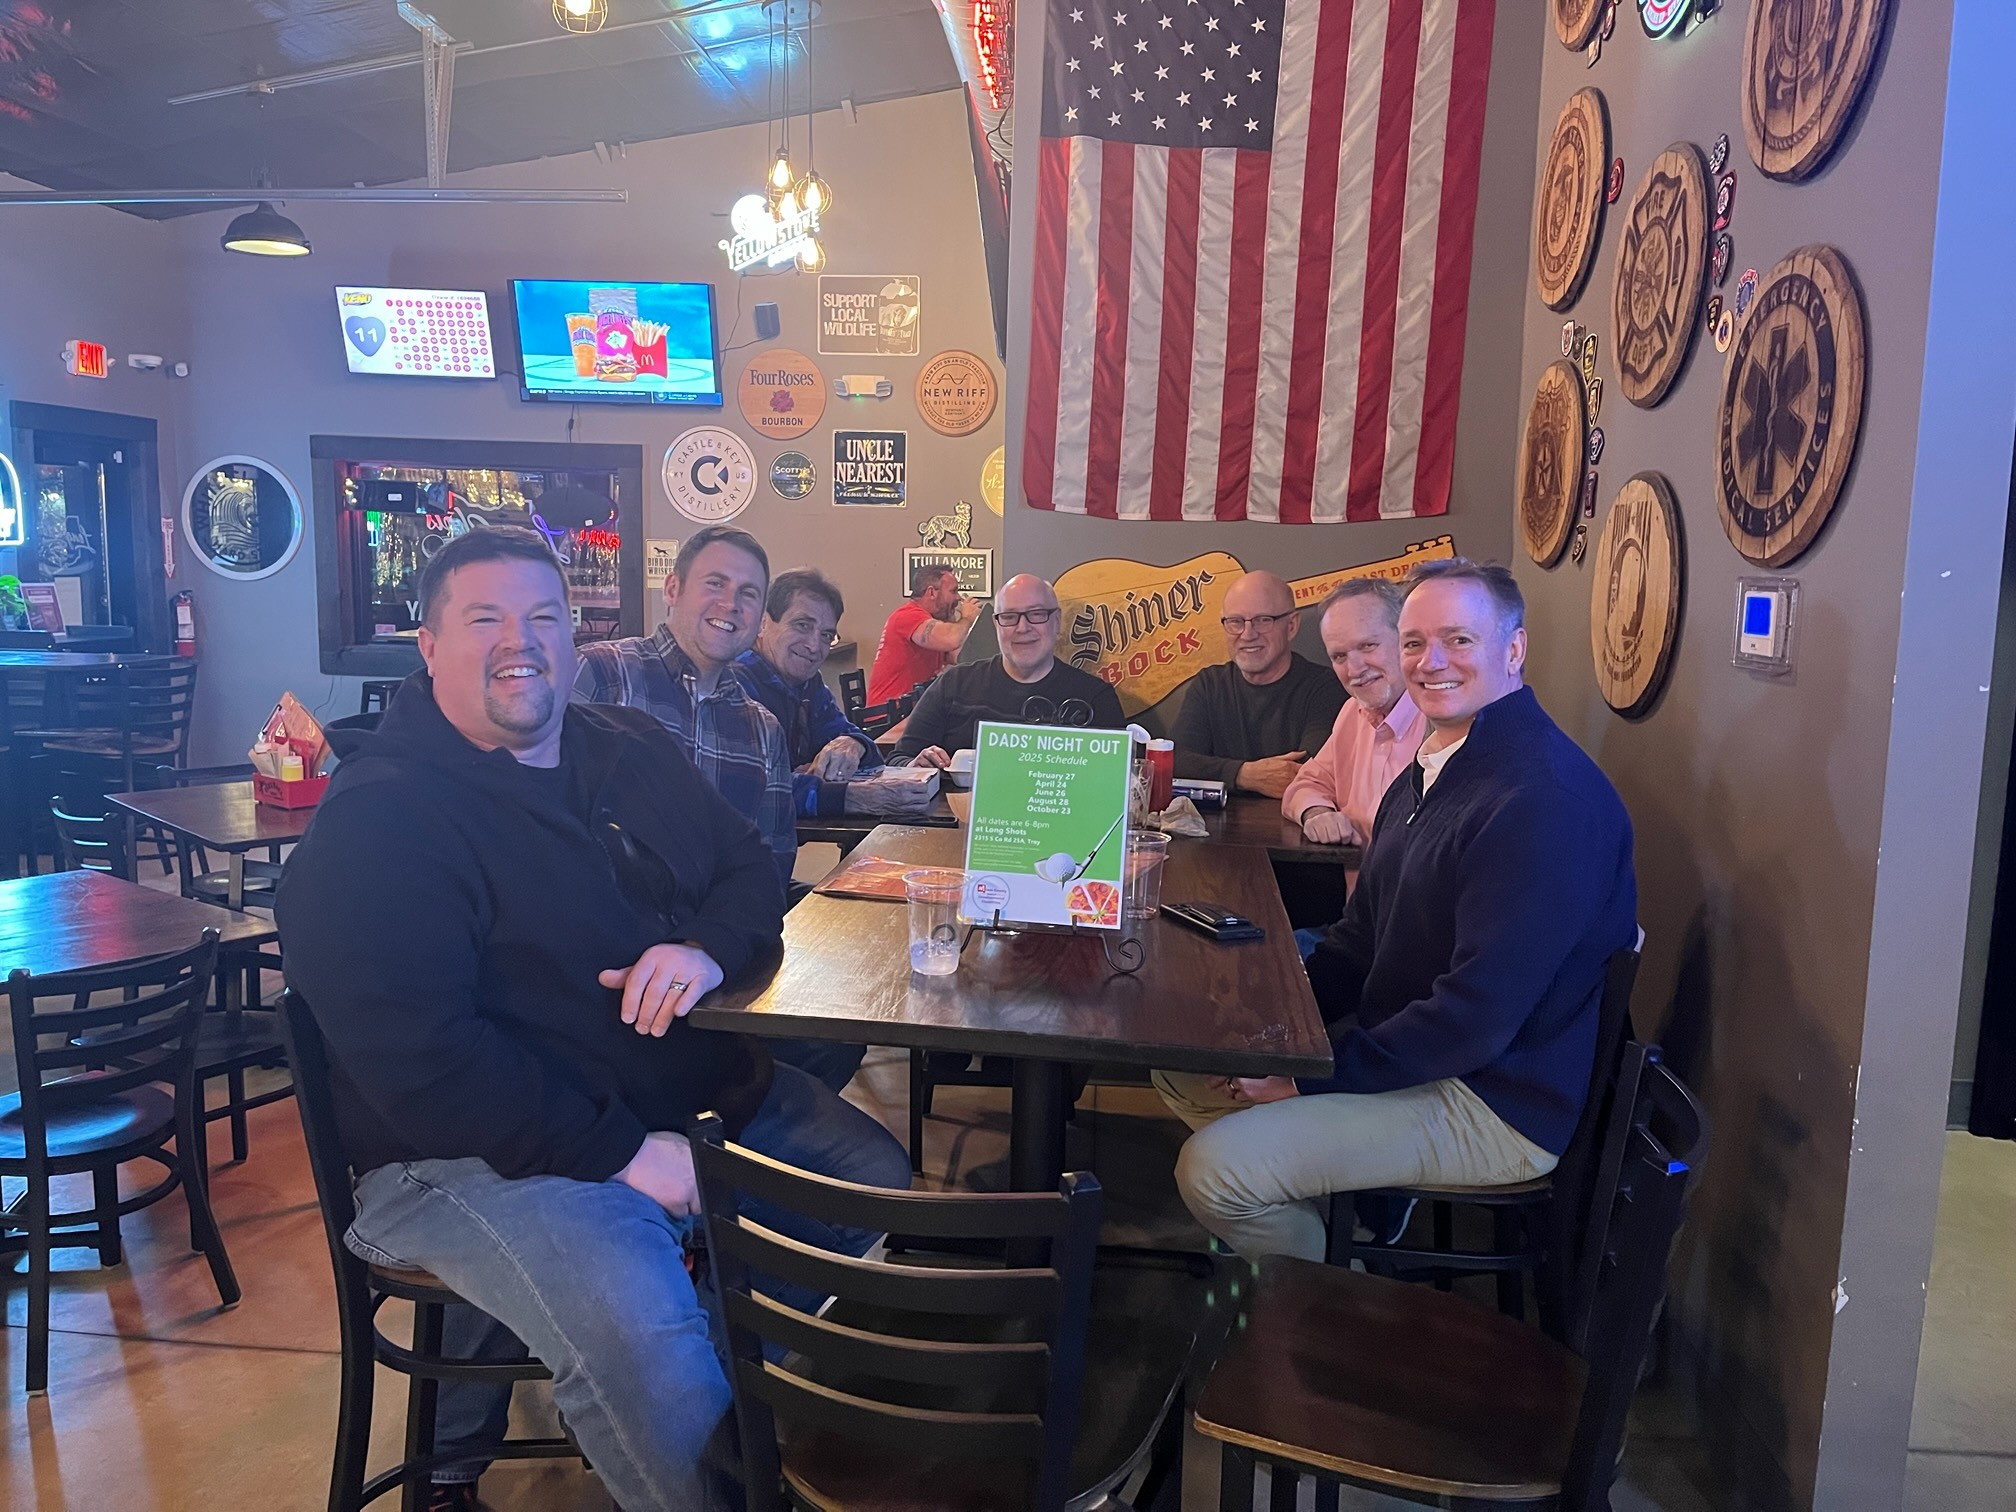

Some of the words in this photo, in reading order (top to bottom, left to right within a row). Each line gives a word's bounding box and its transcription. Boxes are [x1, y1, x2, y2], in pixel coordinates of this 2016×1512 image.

[823, 293, 877, 308] SUPPORT
[831, 308, 869, 322] LOCAL
[1737, 279, 1827, 358] EMERGENCY
[354, 327, 378, 343] 11
[823, 321, 877, 337] WILDLIFE
[79, 342, 104, 376] EXIT
[924, 388, 952, 397] NEW
[957, 388, 986, 397] RIFF
[762, 417, 804, 426] BOURBON
[677, 439, 713, 464] CASTLE
[724, 446, 742, 465] KEY
[846, 439, 894, 461] UNCLE
[1722, 405, 1755, 531] MEDICAL
[1764, 384, 1833, 533] SERVICES
[835, 462, 904, 485] NEAREST
[678, 486, 741, 511] DISTILLERY
[1070, 570, 1215, 669] Shiner
[1097, 629, 1202, 687] BOCK
[988, 732, 1032, 748] DADS'
[1037, 736, 1084, 753] NIGHT
[1089, 740, 1121, 755] OUT
[1018, 752, 1043, 763] 2025
[1045, 754, 1088, 766] Schedule
[1028, 770, 1064, 781] February
[1065, 773, 1075, 781] 27
[1035, 779, 1056, 789] April
[1057, 781, 1067, 789] 24
[1035, 788, 1054, 797] June
[1028, 797, 1057, 807] August
[1058, 798, 1069, 806] 28
[1027, 805, 1060, 814] October
[1061, 807, 1071, 815] 23
[977, 817, 987, 825] All
[988, 818, 1009, 827] dates
[985, 826, 1004, 836] Long
[1005, 828, 1027, 836] Shots
